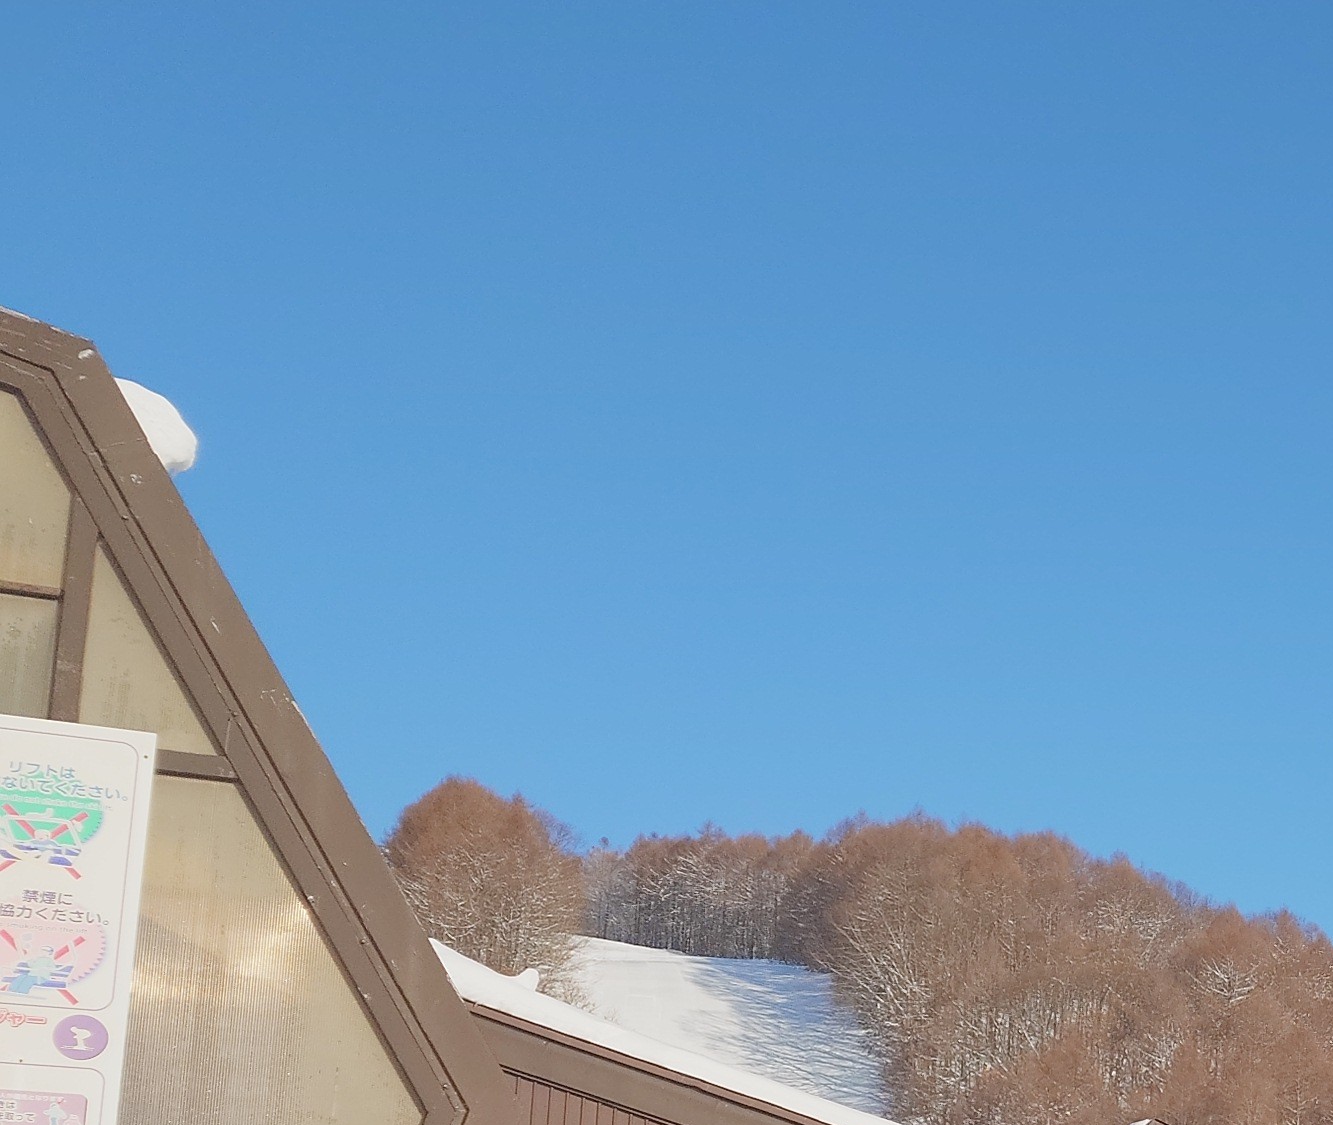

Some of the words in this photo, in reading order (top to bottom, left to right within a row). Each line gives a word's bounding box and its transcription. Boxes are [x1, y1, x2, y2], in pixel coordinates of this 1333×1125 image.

[9, 760, 76, 779] リフトは
[21, 888, 74, 907] 禁煙に
